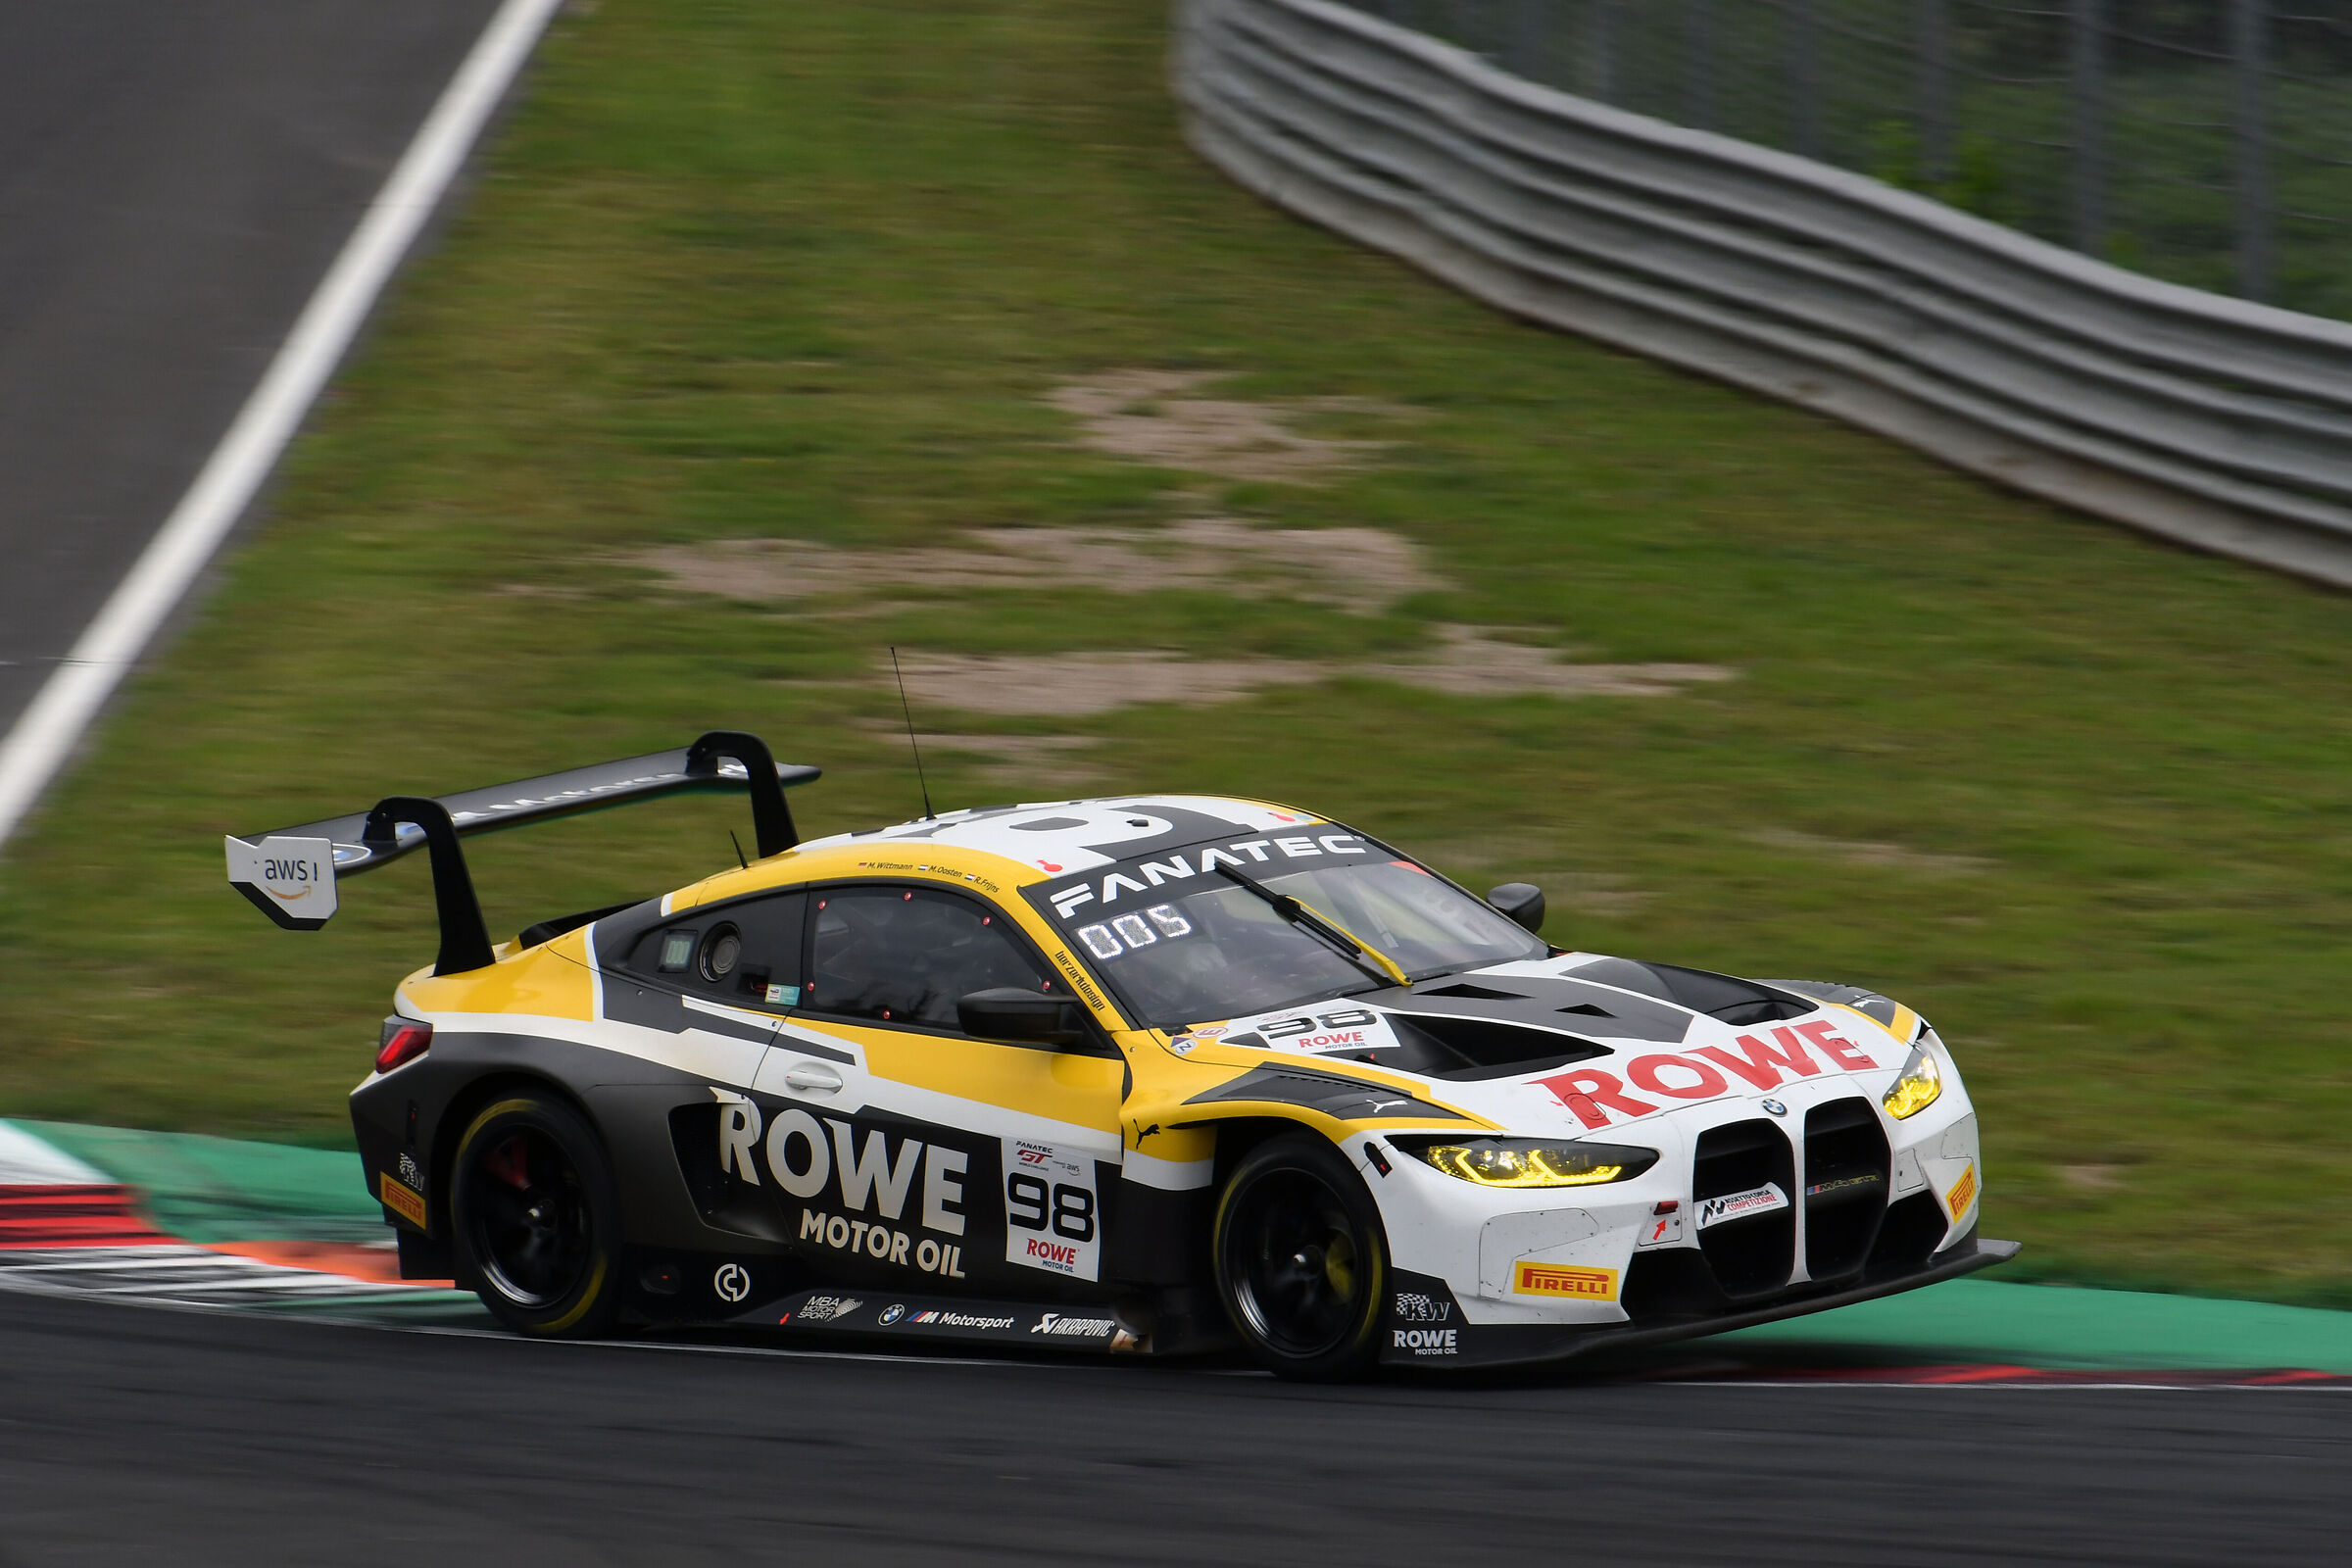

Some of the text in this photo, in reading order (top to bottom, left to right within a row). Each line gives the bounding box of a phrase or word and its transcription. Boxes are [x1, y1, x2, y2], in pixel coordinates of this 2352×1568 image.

[265, 859, 308, 881] aws
[1050, 835, 1366, 919] FANATEC
[1257, 1009, 1377, 1040] 98
[1298, 1031, 1364, 1049] ROWE
[1521, 1019, 1880, 1130] ROWE
[1016, 1141, 1054, 1153] FANATEC
[709, 1086, 968, 1236] ROWE
[385, 1179, 421, 1221] PIRELLI
[1725, 1189, 1772, 1204] ASSETTO CORSA
[1727, 1195, 1778, 1211] COMPETIZIONE
[1950, 1171, 1974, 1216] PIRELLI
[1007, 1172, 1095, 1243] 98
[800, 1208, 965, 1279] MOTOR OIL
[1026, 1238, 1076, 1264] ROWE
[1042, 1260, 1063, 1271] MOTOR
[1522, 1268, 1609, 1294] PIRELLI
[807, 1296, 840, 1307] MBA
[1405, 1301, 1450, 1321] KW
[797, 1311, 831, 1320] SPORT
[939, 1312, 1014, 1330] Motorsport
[1393, 1329, 1457, 1348] ROWE
